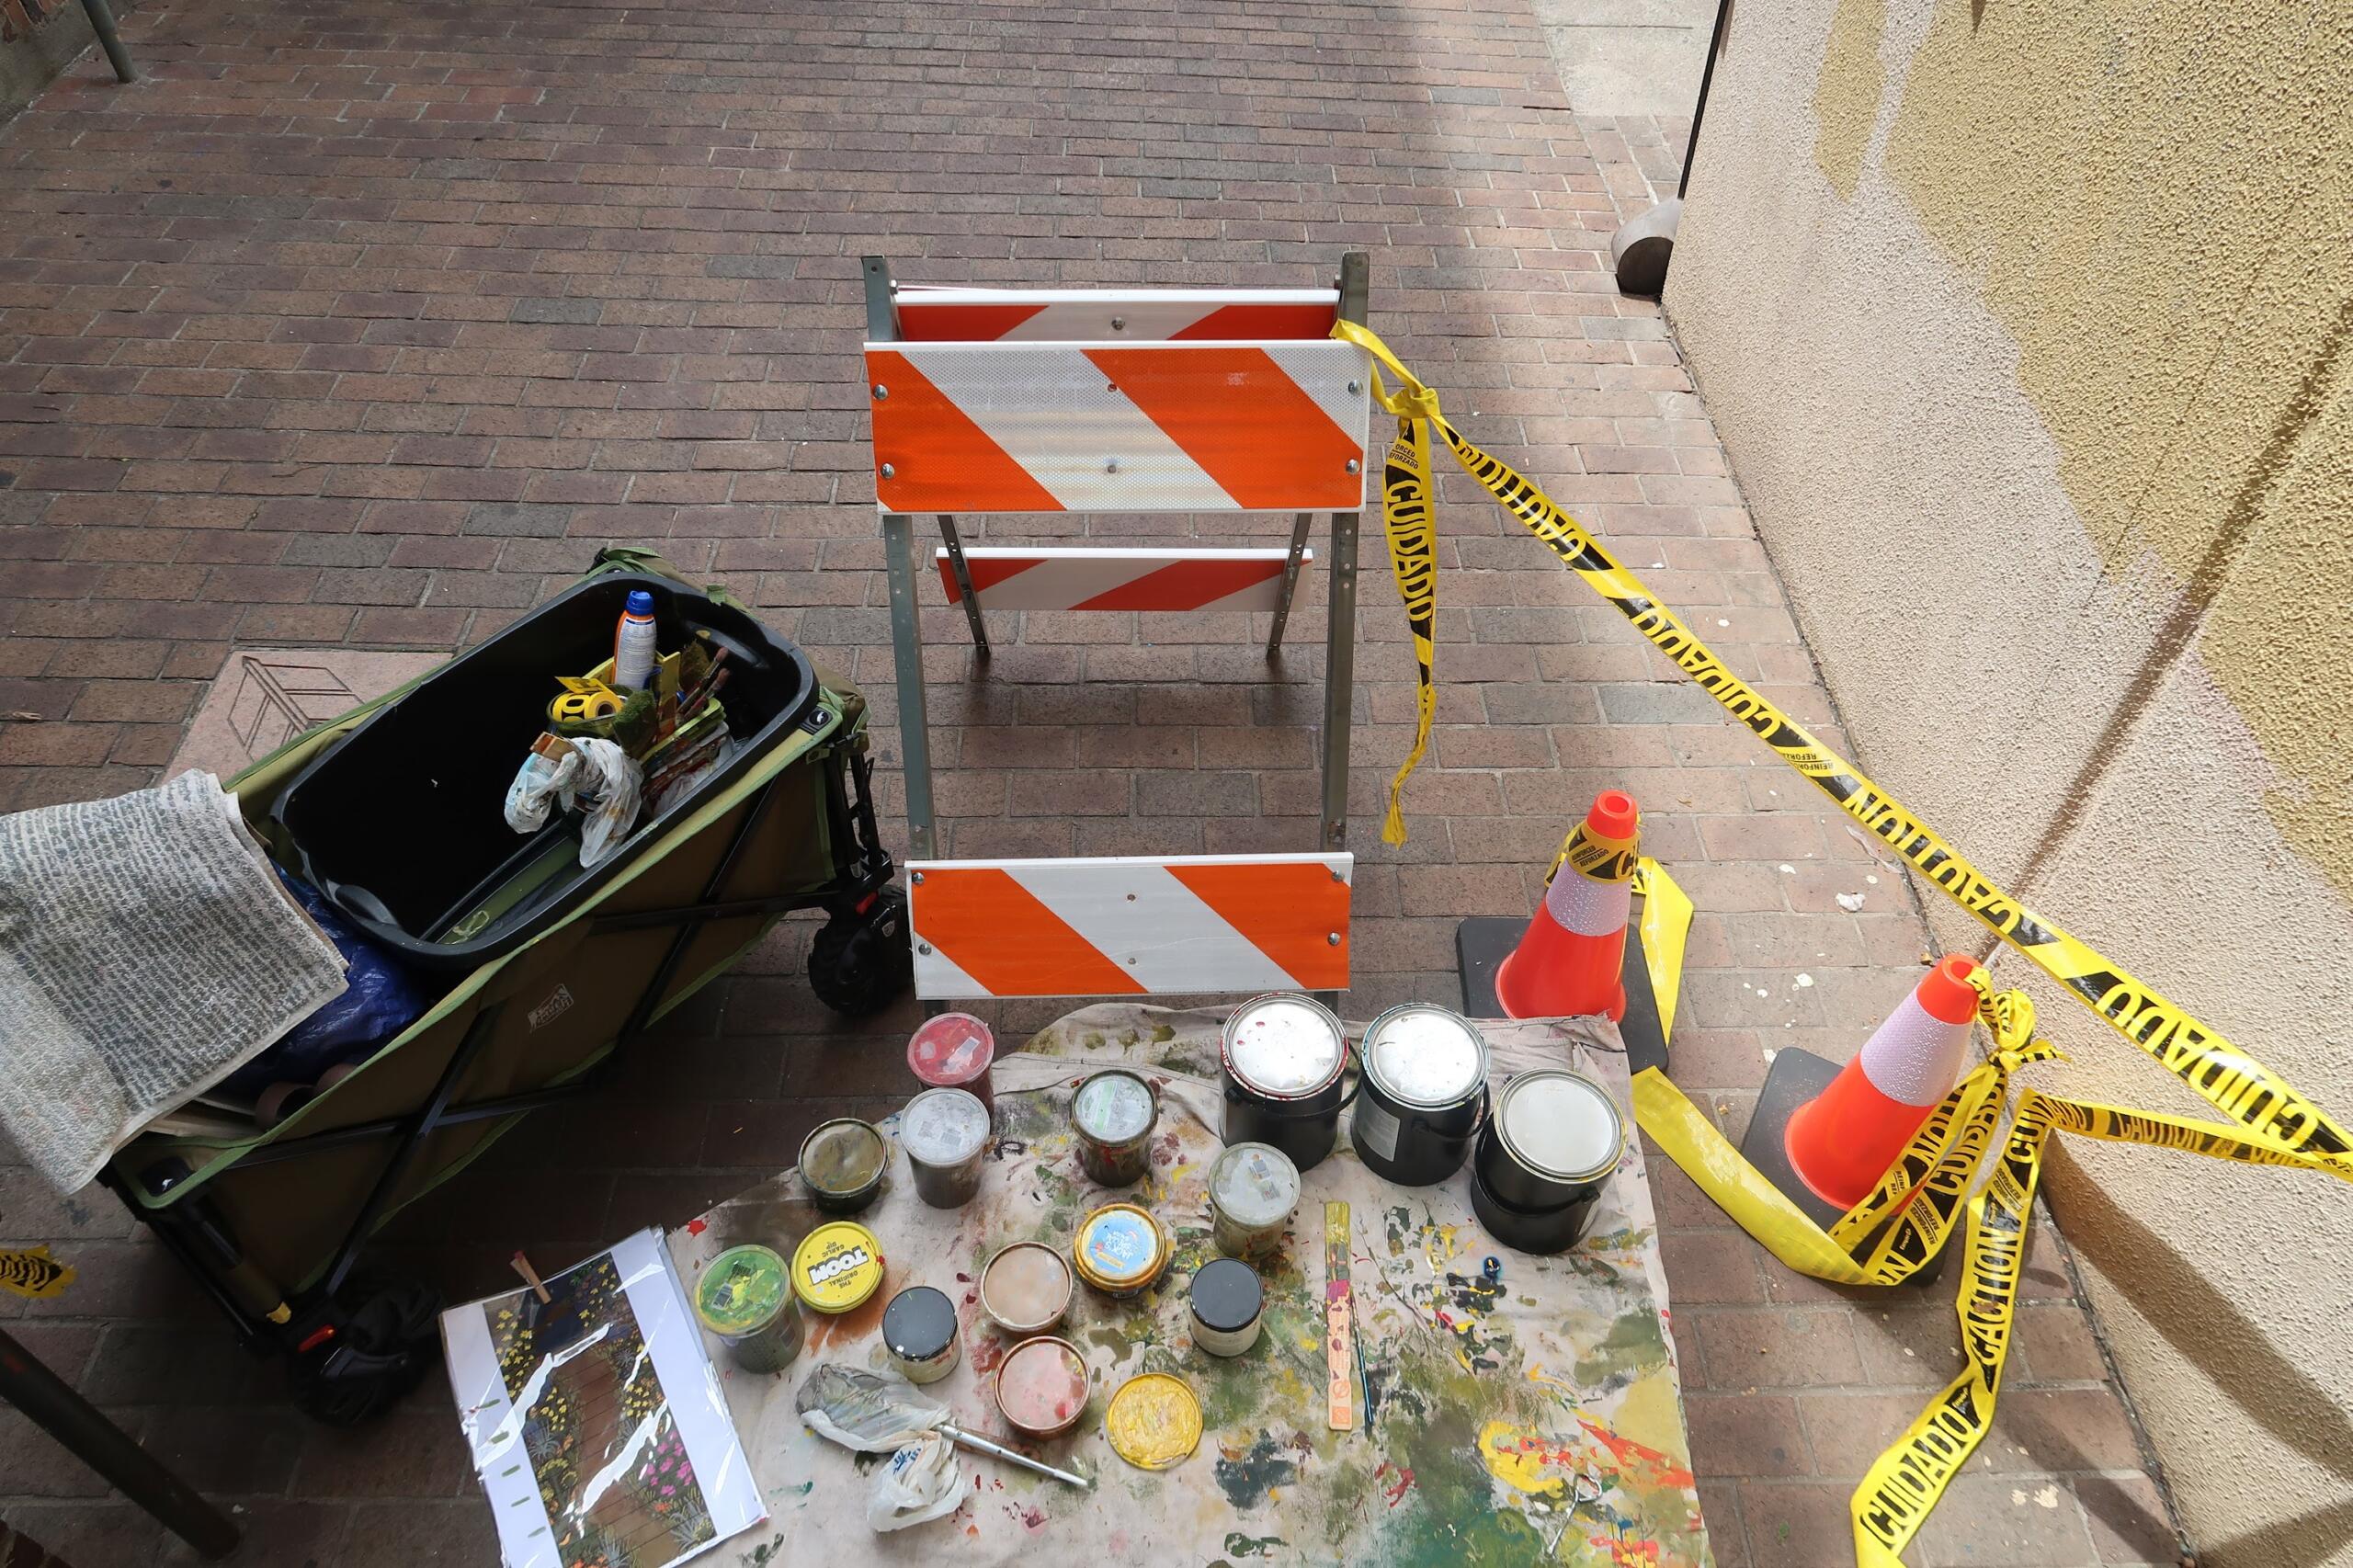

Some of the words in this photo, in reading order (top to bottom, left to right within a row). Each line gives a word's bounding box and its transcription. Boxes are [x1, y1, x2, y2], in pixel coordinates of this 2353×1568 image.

[1387, 480, 1434, 621] CUIDADO
[1458, 441, 1587, 562] CAUTION
[1630, 607, 1782, 740] CUIDADO
[1845, 783, 2023, 936] CAUTION
[2095, 983, 2320, 1151] CUIDADO
[2117, 1111, 2205, 1148] CAUTION
[808, 1246, 869, 1285] TOOM
[822, 1244, 845, 1257] GARLIC
[829, 1270, 858, 1286] ORIGINAL
[839, 1279, 852, 1288] THE
[1967, 1228, 2021, 1366] CAUTION
[1864, 1406, 1978, 1543] CUIDADO
